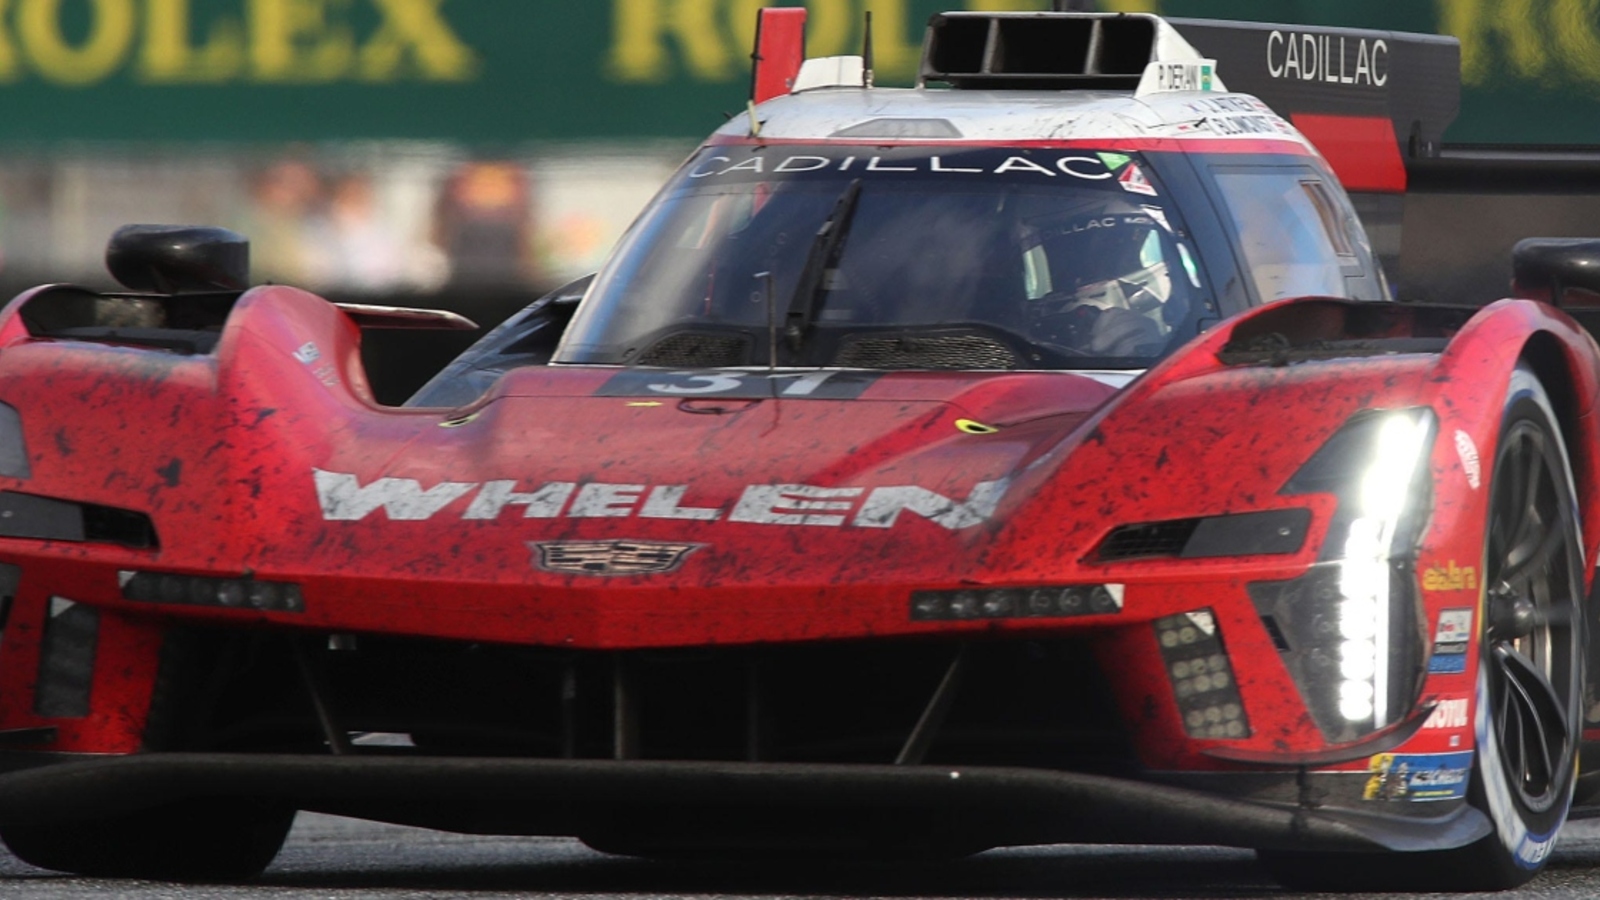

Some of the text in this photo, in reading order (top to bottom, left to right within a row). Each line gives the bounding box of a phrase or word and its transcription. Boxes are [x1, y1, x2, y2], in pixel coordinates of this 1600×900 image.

[0, 0, 480, 86] OLEX
[1266, 30, 1388, 87] CADILLAC
[687, 154, 1113, 180] CADILLAC
[647, 370, 842, 395] 31
[311, 467, 1010, 531] WHELEN
